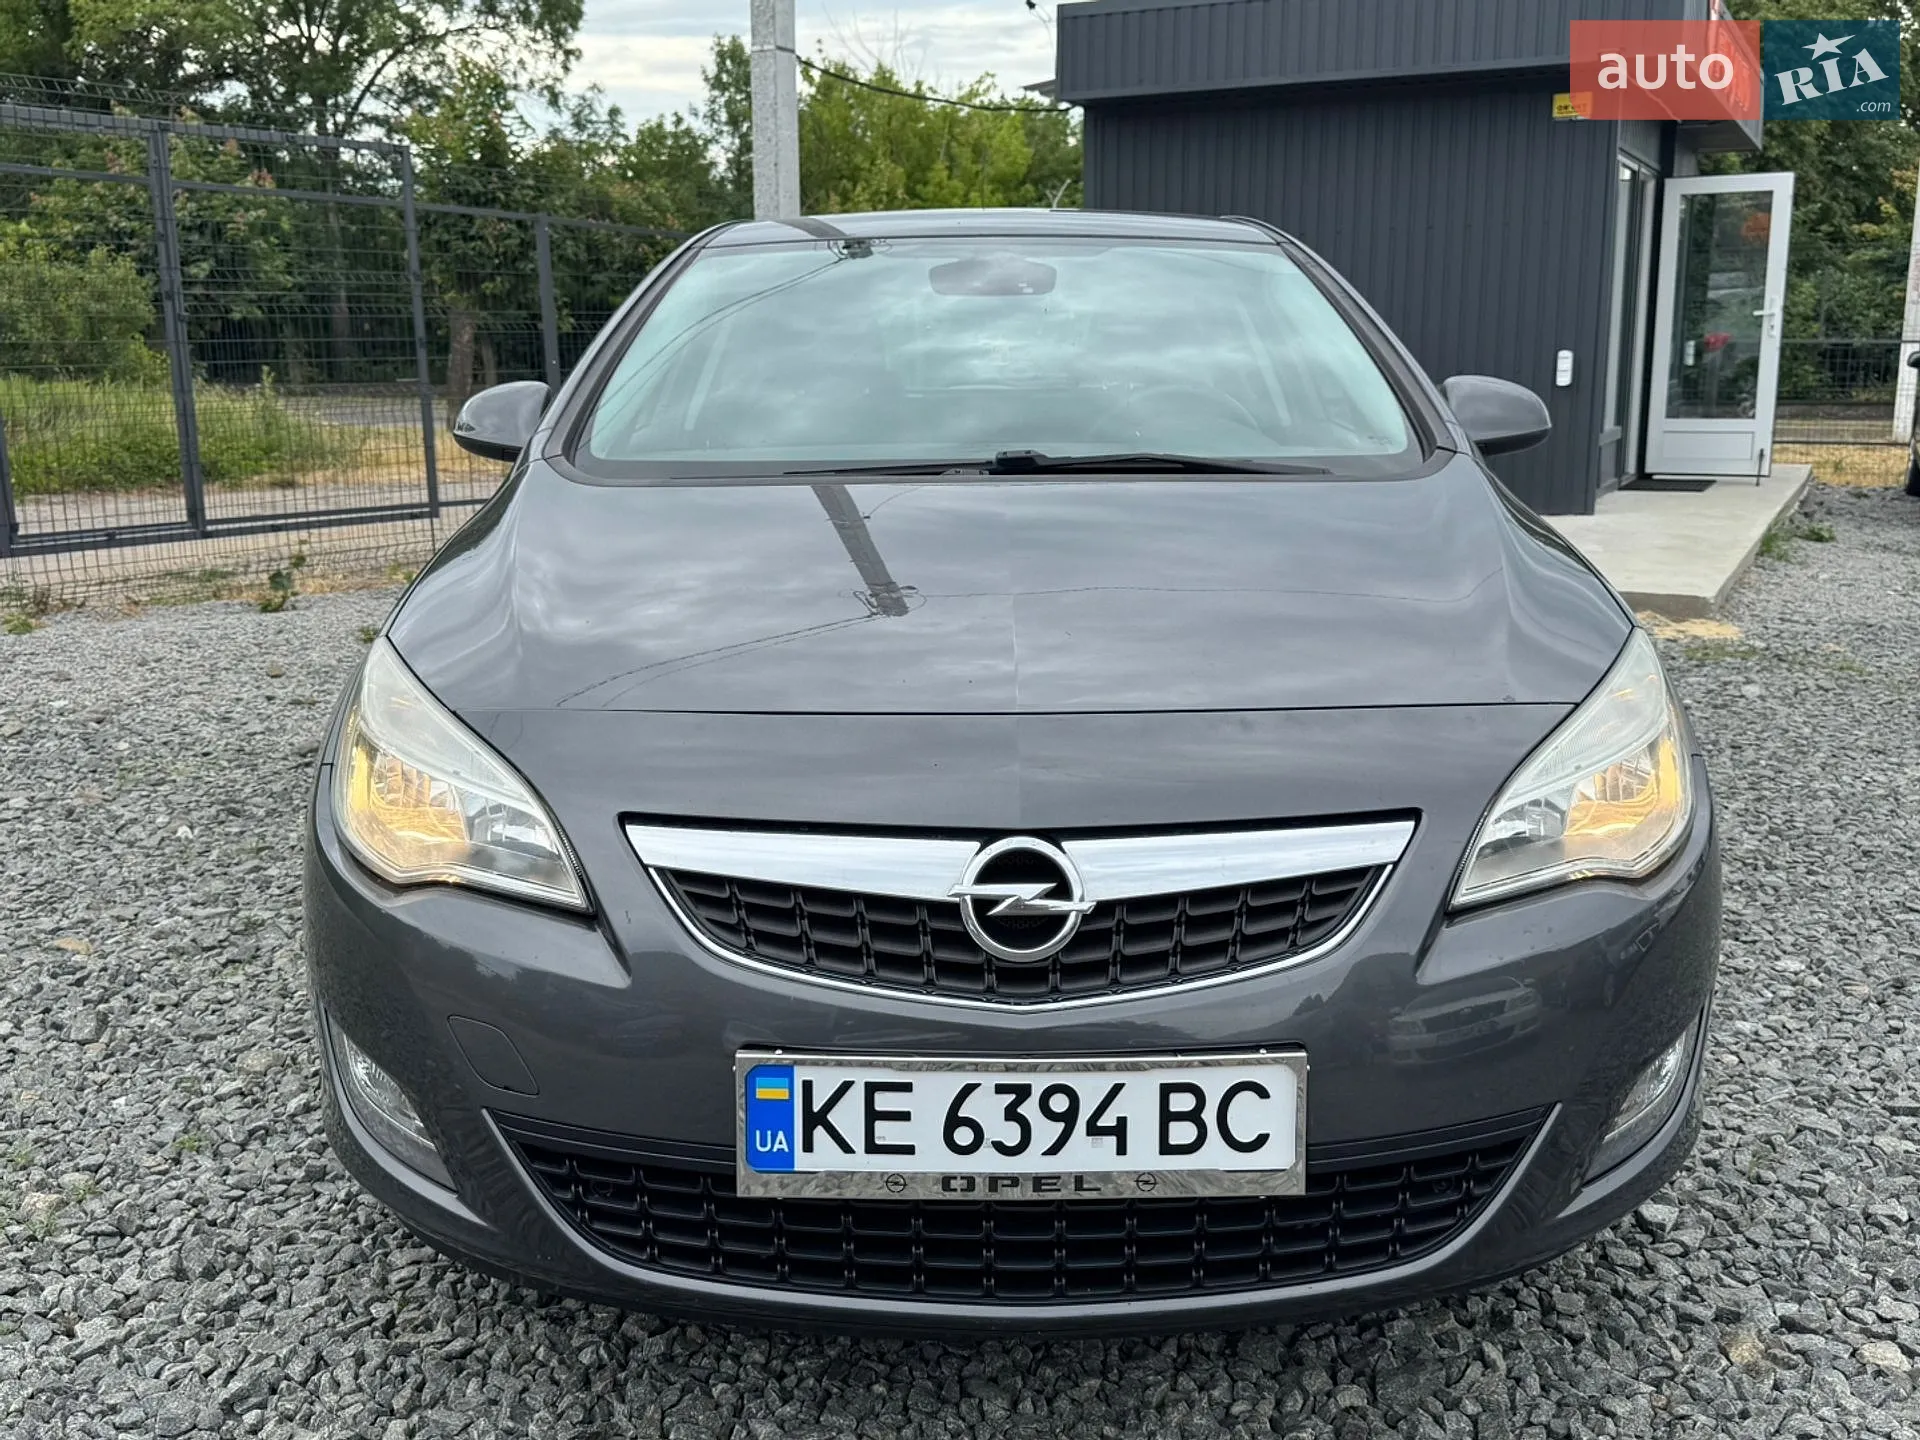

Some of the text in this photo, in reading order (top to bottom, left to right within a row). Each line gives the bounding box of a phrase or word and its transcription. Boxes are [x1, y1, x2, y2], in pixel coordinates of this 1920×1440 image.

[801, 1079, 1271, 1157] KE 6394 BC
[755, 1129, 789, 1153] UA
[941, 1174, 1102, 1194] OPEL
